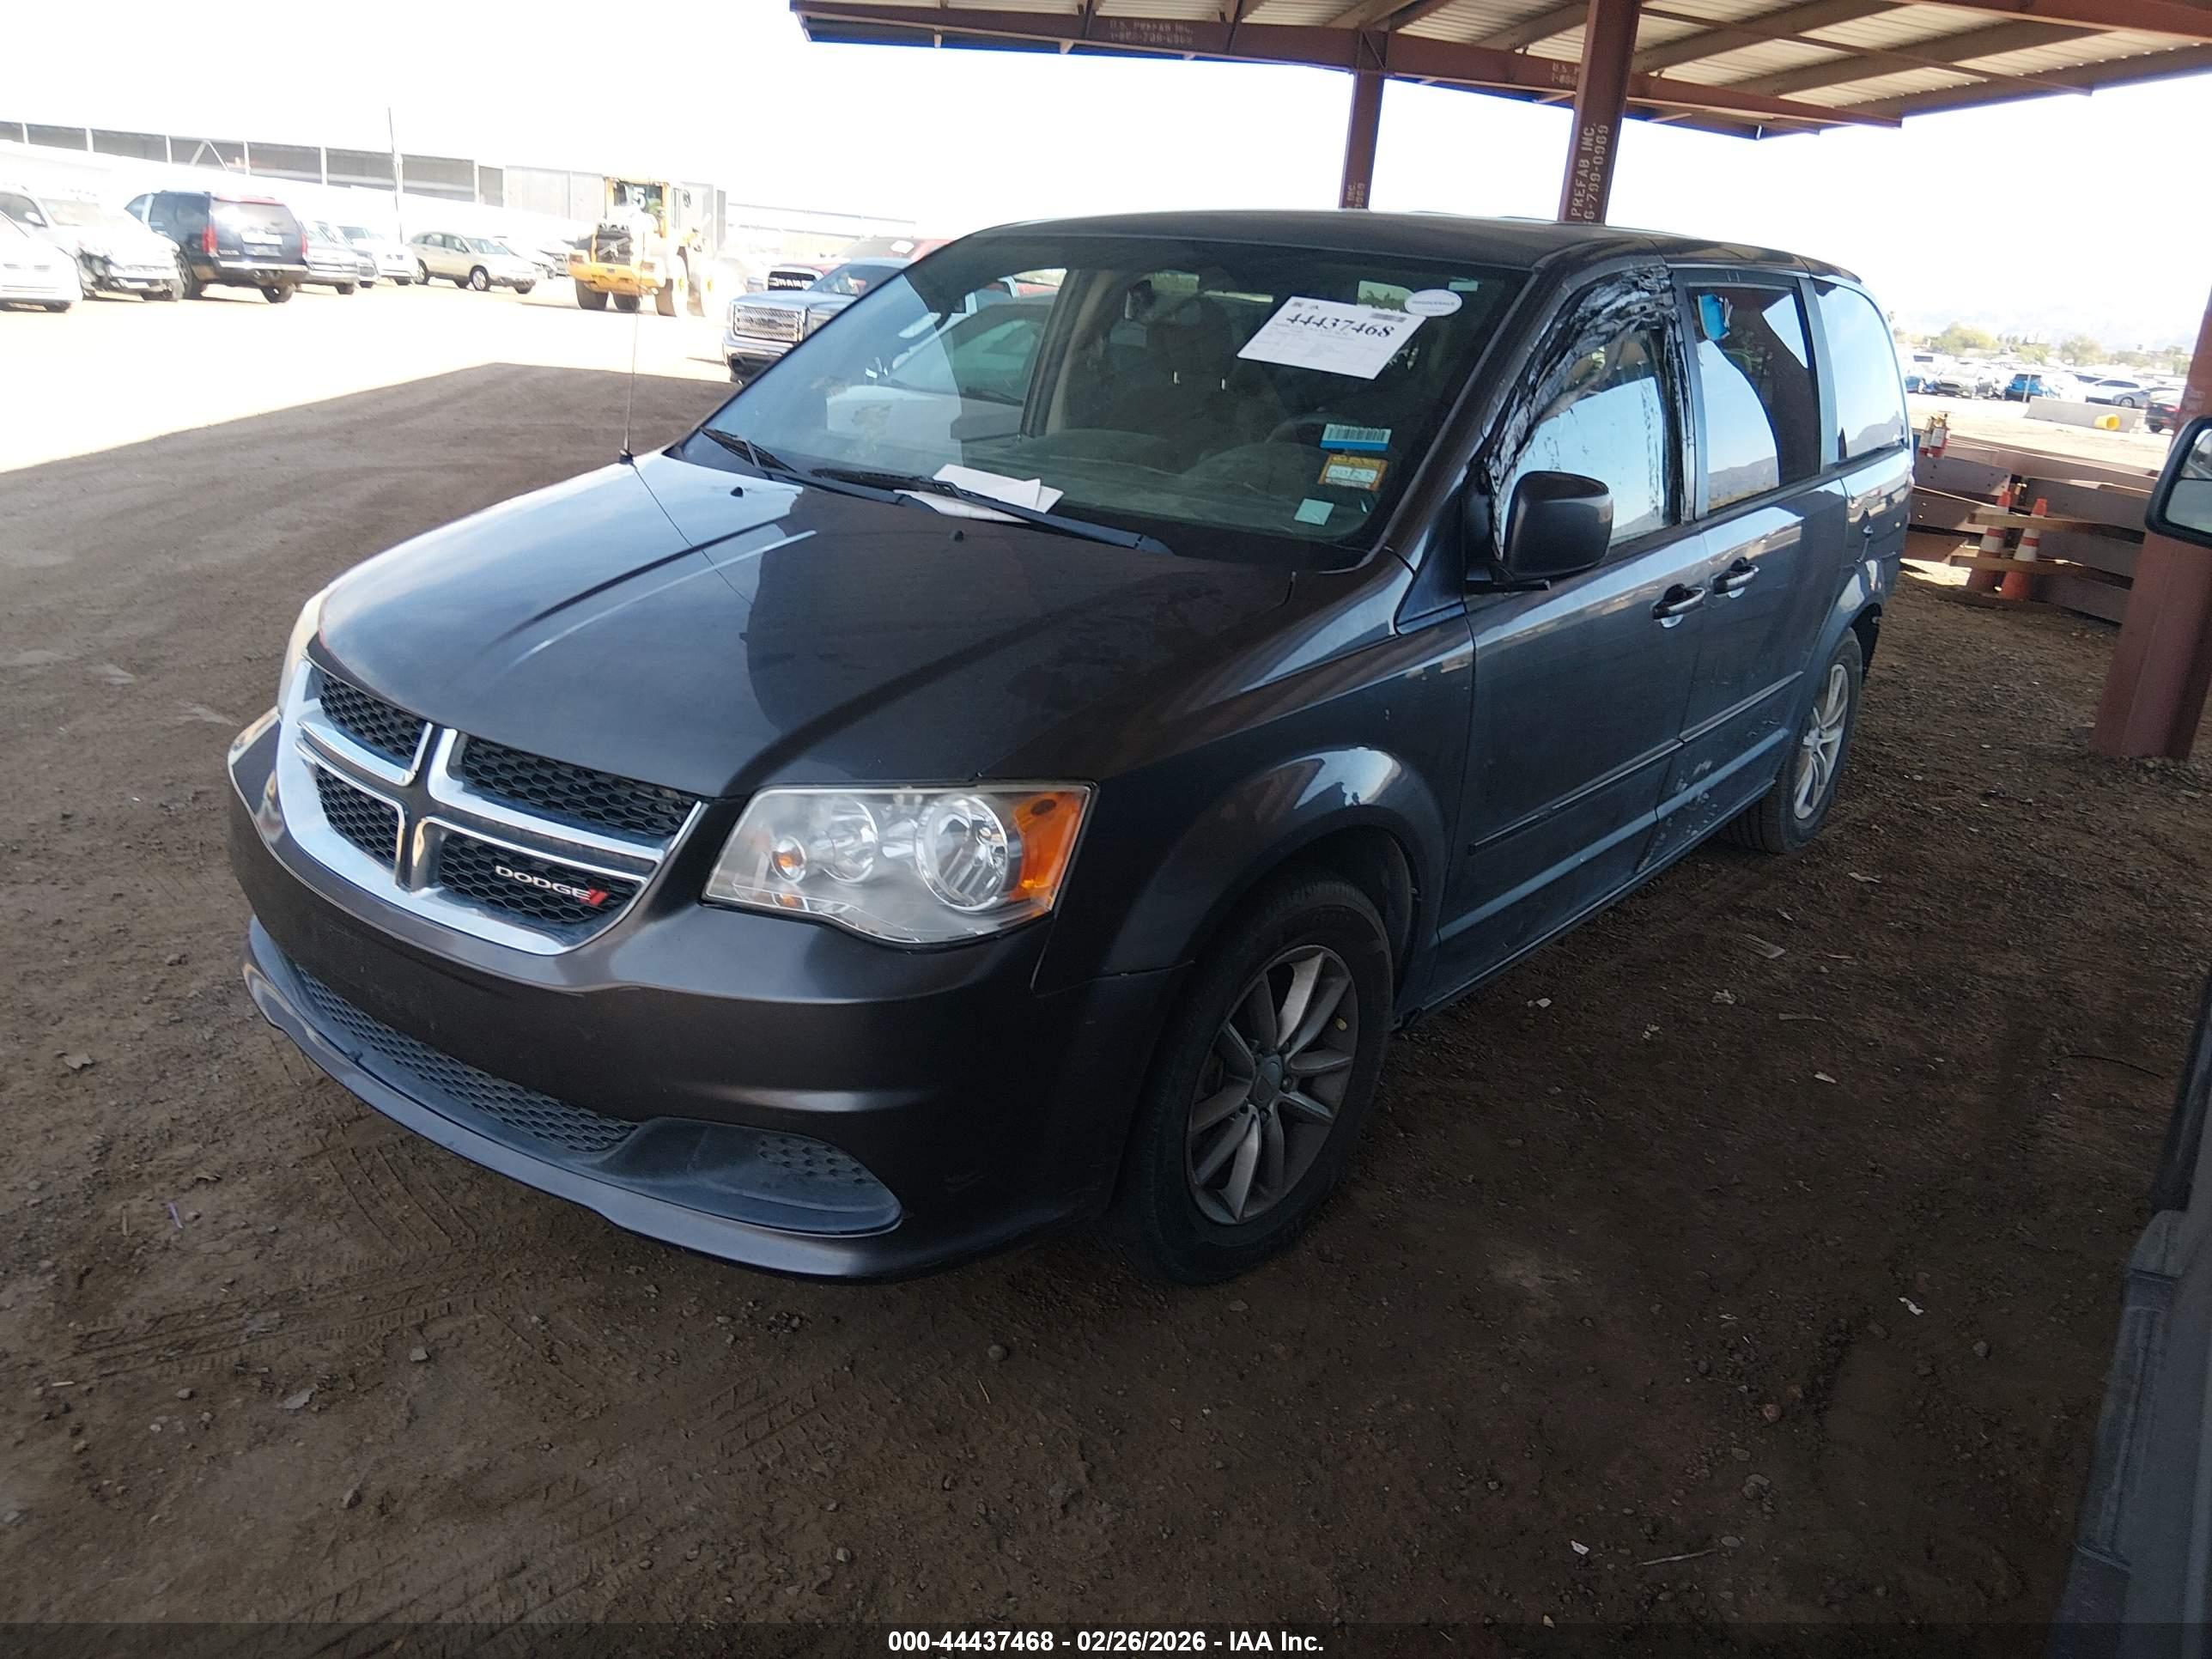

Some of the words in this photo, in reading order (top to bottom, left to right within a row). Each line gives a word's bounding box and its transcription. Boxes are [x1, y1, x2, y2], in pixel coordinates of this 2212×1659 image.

[1571, 158, 1590, 217] PREFAB
[1581, 123, 1596, 152] INC.
[1286, 313, 1395, 338] 44437468
[495, 865, 592, 902] DODGE
